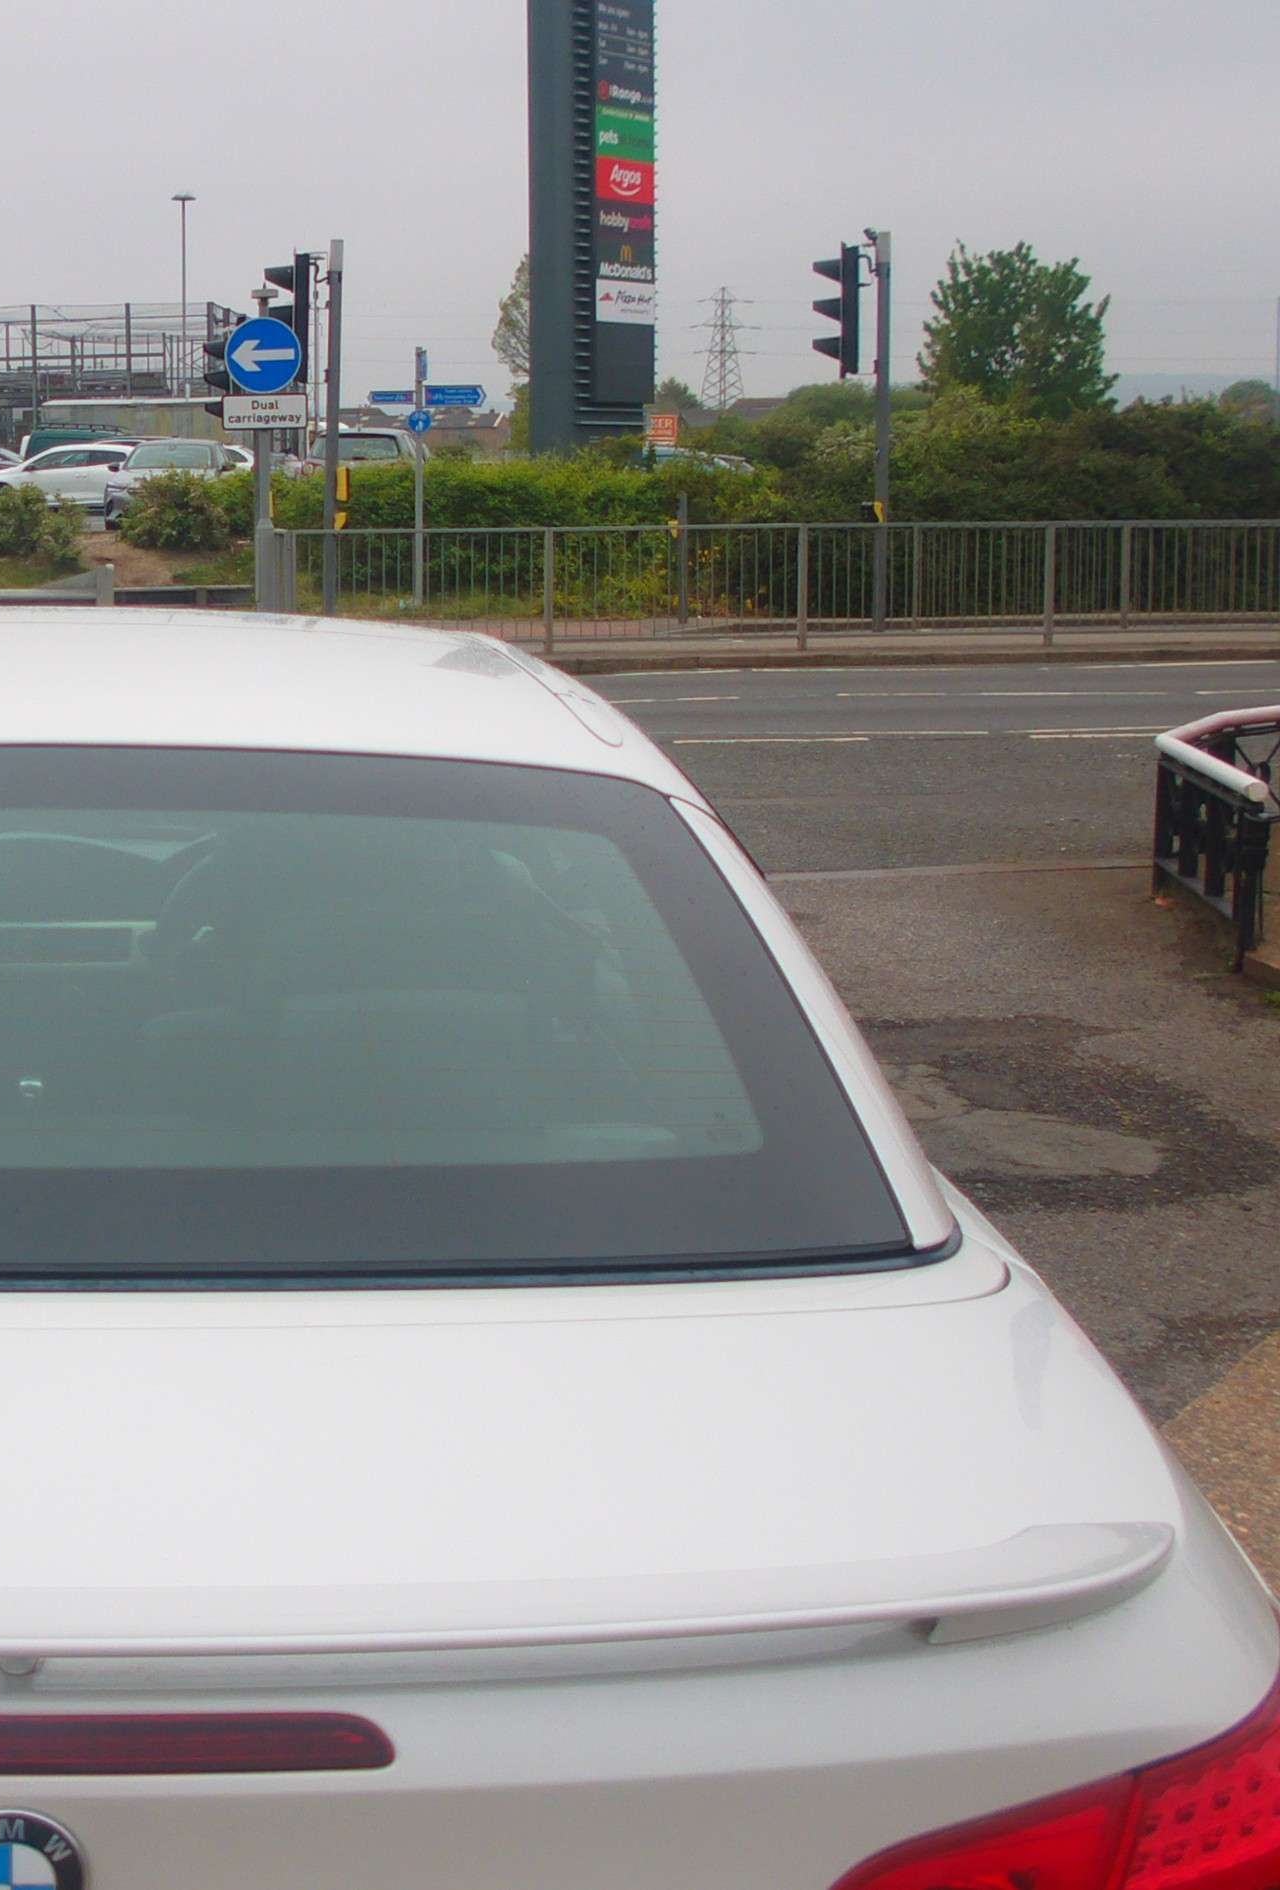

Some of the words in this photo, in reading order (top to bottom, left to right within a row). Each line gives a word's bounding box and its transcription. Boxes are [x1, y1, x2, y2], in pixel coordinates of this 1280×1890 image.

[599, 130, 619, 146] pets
[609, 163, 642, 188] Argos
[599, 261, 652, 280] McDonald's
[251, 400, 279, 410] Dual
[227, 413, 302, 424] carriageway
